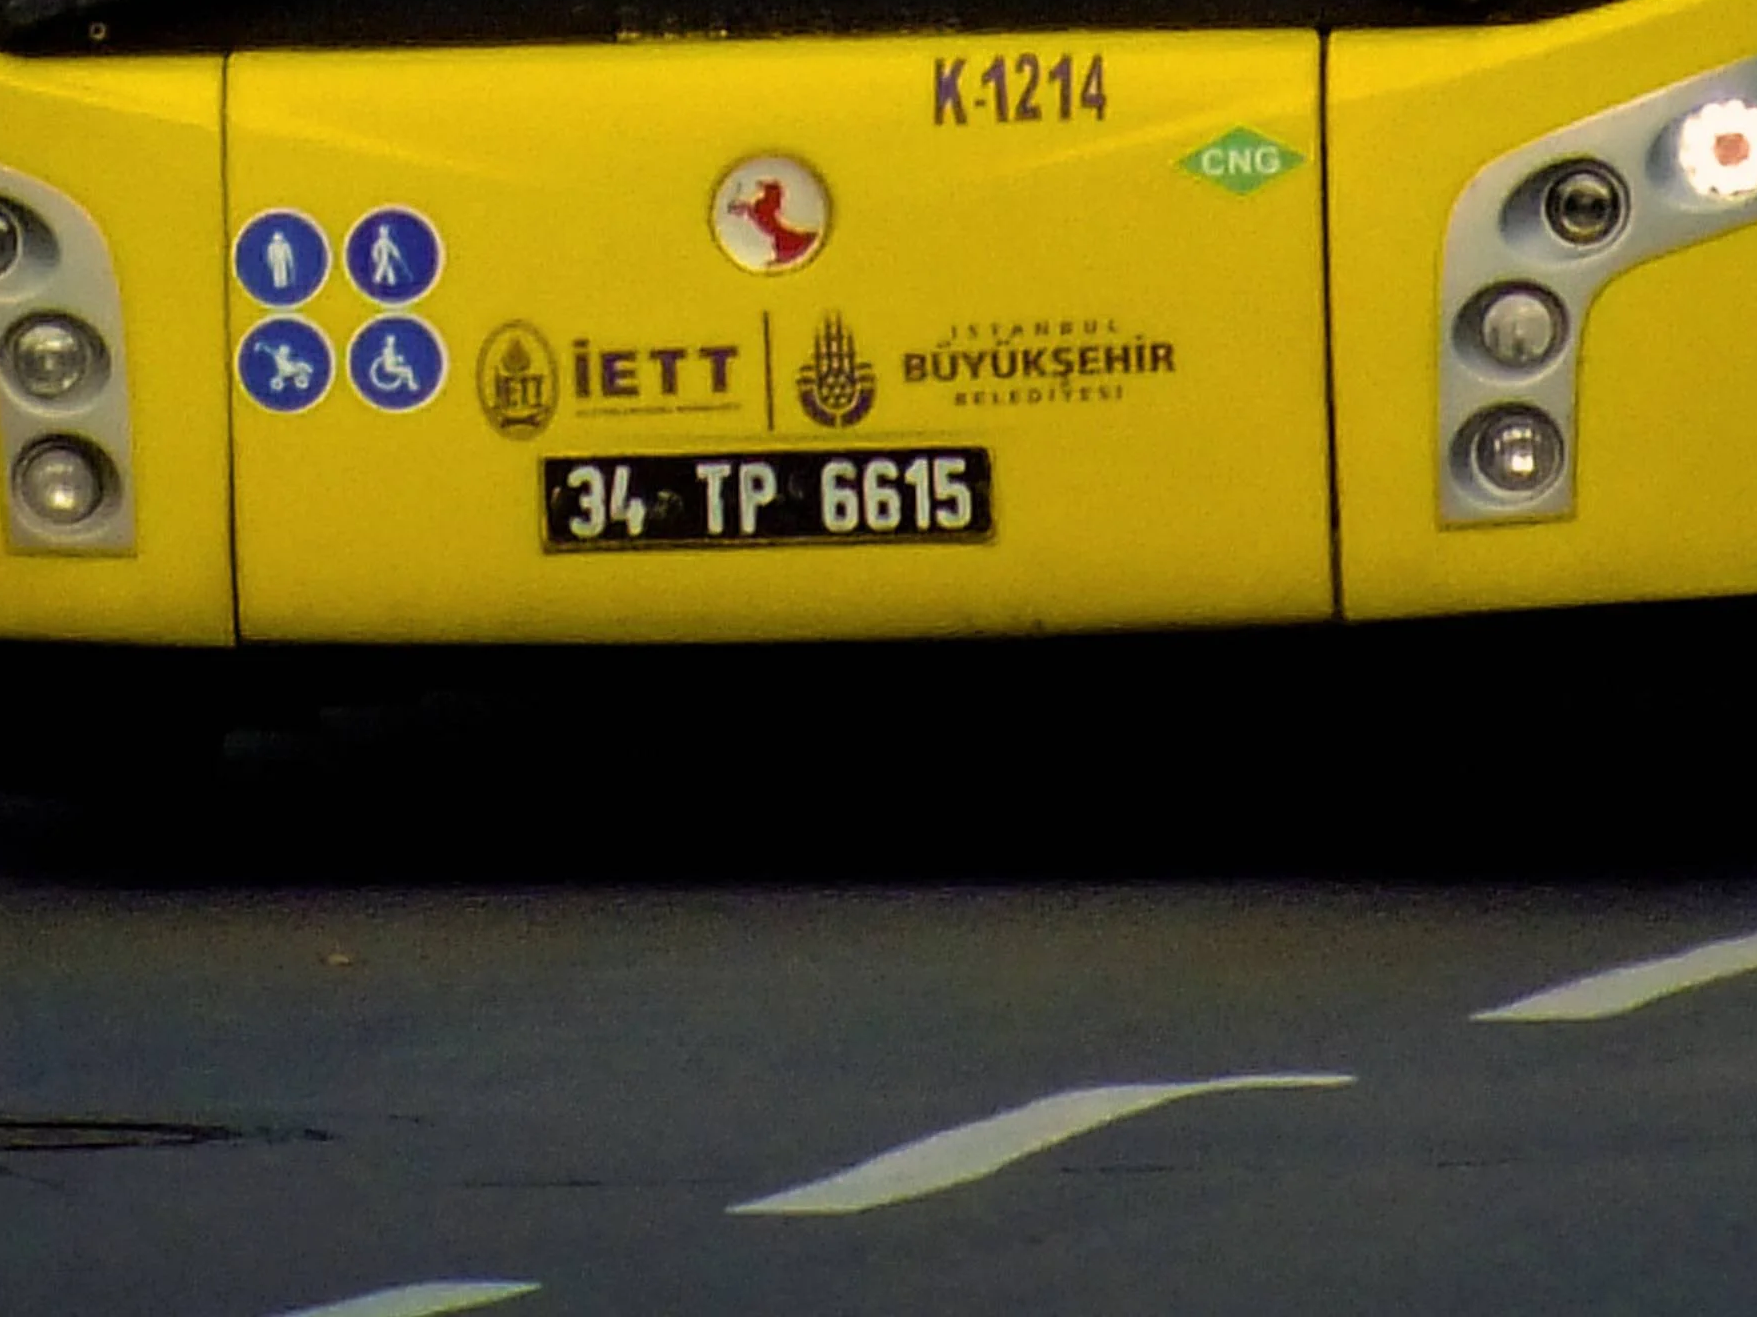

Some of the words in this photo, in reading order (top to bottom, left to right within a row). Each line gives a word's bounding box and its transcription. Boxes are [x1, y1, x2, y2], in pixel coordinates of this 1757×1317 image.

[933, 52, 1107, 126] K-1214
[1200, 145, 1281, 178] CNG
[572, 337, 739, 398] İETT
[903, 333, 1176, 387] BÜYÜKŞEHİR
[567, 464, 646, 539] 34
[695, 461, 778, 535] TP
[820, 457, 972, 532] 6615
